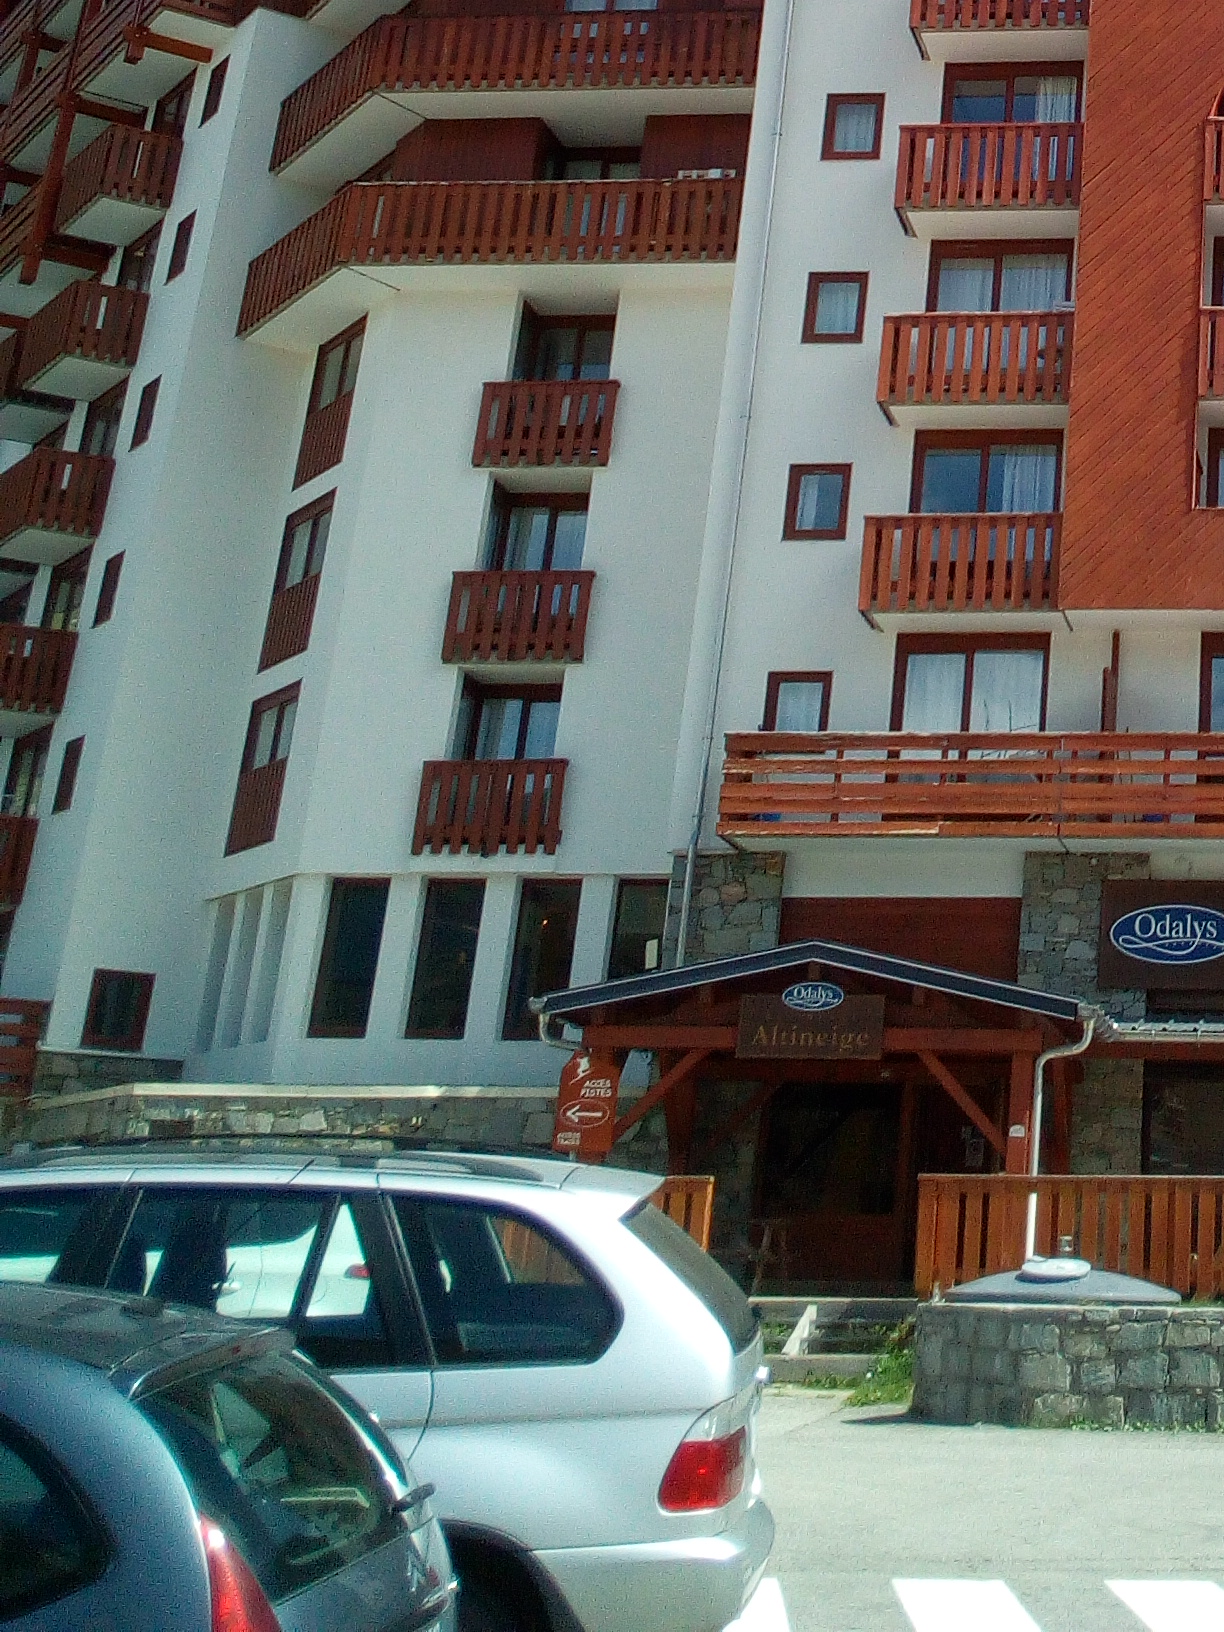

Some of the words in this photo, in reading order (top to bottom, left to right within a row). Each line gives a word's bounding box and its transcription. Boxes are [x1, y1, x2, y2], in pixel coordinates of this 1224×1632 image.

[1134, 913, 1218, 955] Odalys
[793, 986, 834, 1007] Odalys
[752, 1024, 870, 1053] Altineige
